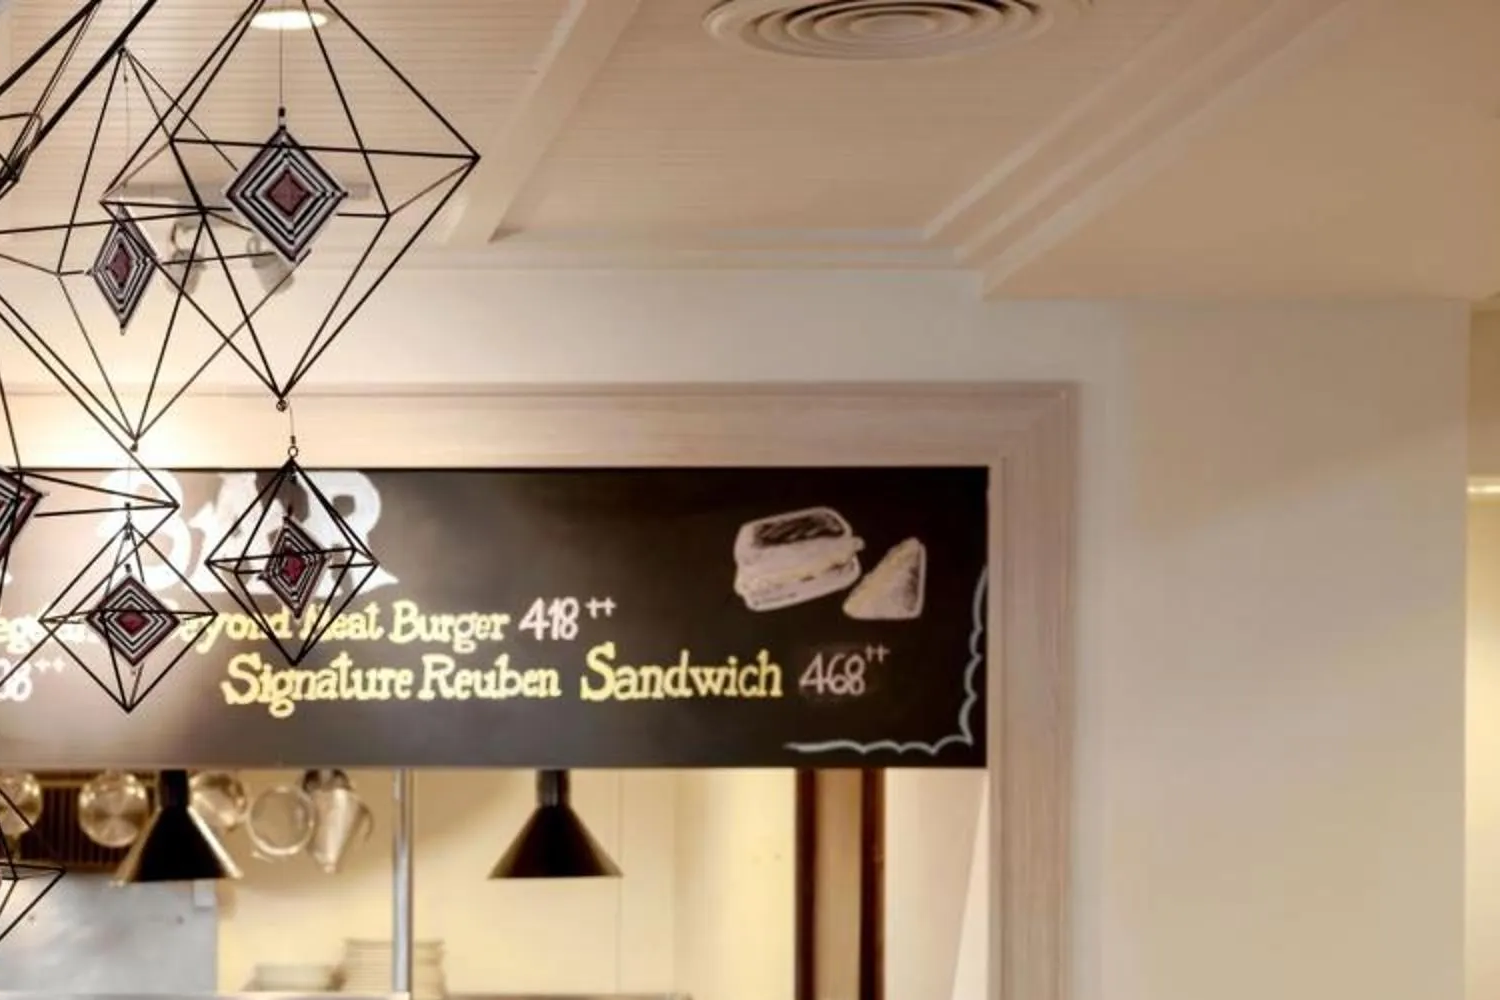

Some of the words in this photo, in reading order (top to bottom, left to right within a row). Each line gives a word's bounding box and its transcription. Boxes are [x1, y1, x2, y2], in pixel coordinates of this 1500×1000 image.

[165, 602, 293, 655] eyond
[388, 599, 511, 654] Burger
[219, 651, 414, 718] Signature
[417, 653, 562, 701] Reuben
[580, 641, 784, 702] Sandwich
